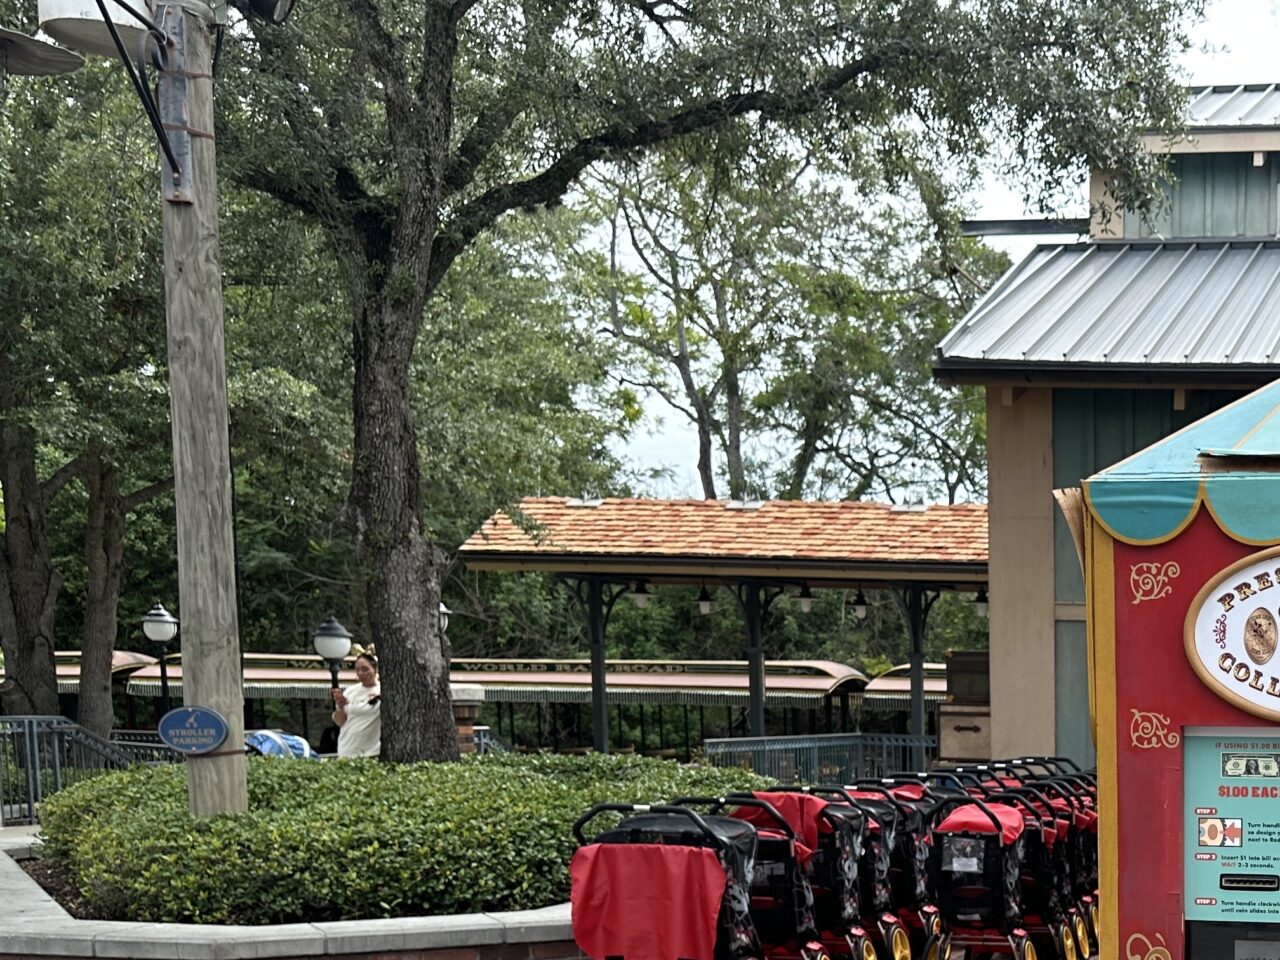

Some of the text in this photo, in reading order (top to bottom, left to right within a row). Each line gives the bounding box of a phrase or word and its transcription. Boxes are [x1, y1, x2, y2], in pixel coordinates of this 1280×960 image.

[461, 662, 548, 673] WORLD
[168, 728, 217, 737] STROLLER
[172, 736, 214, 745] PARKING
